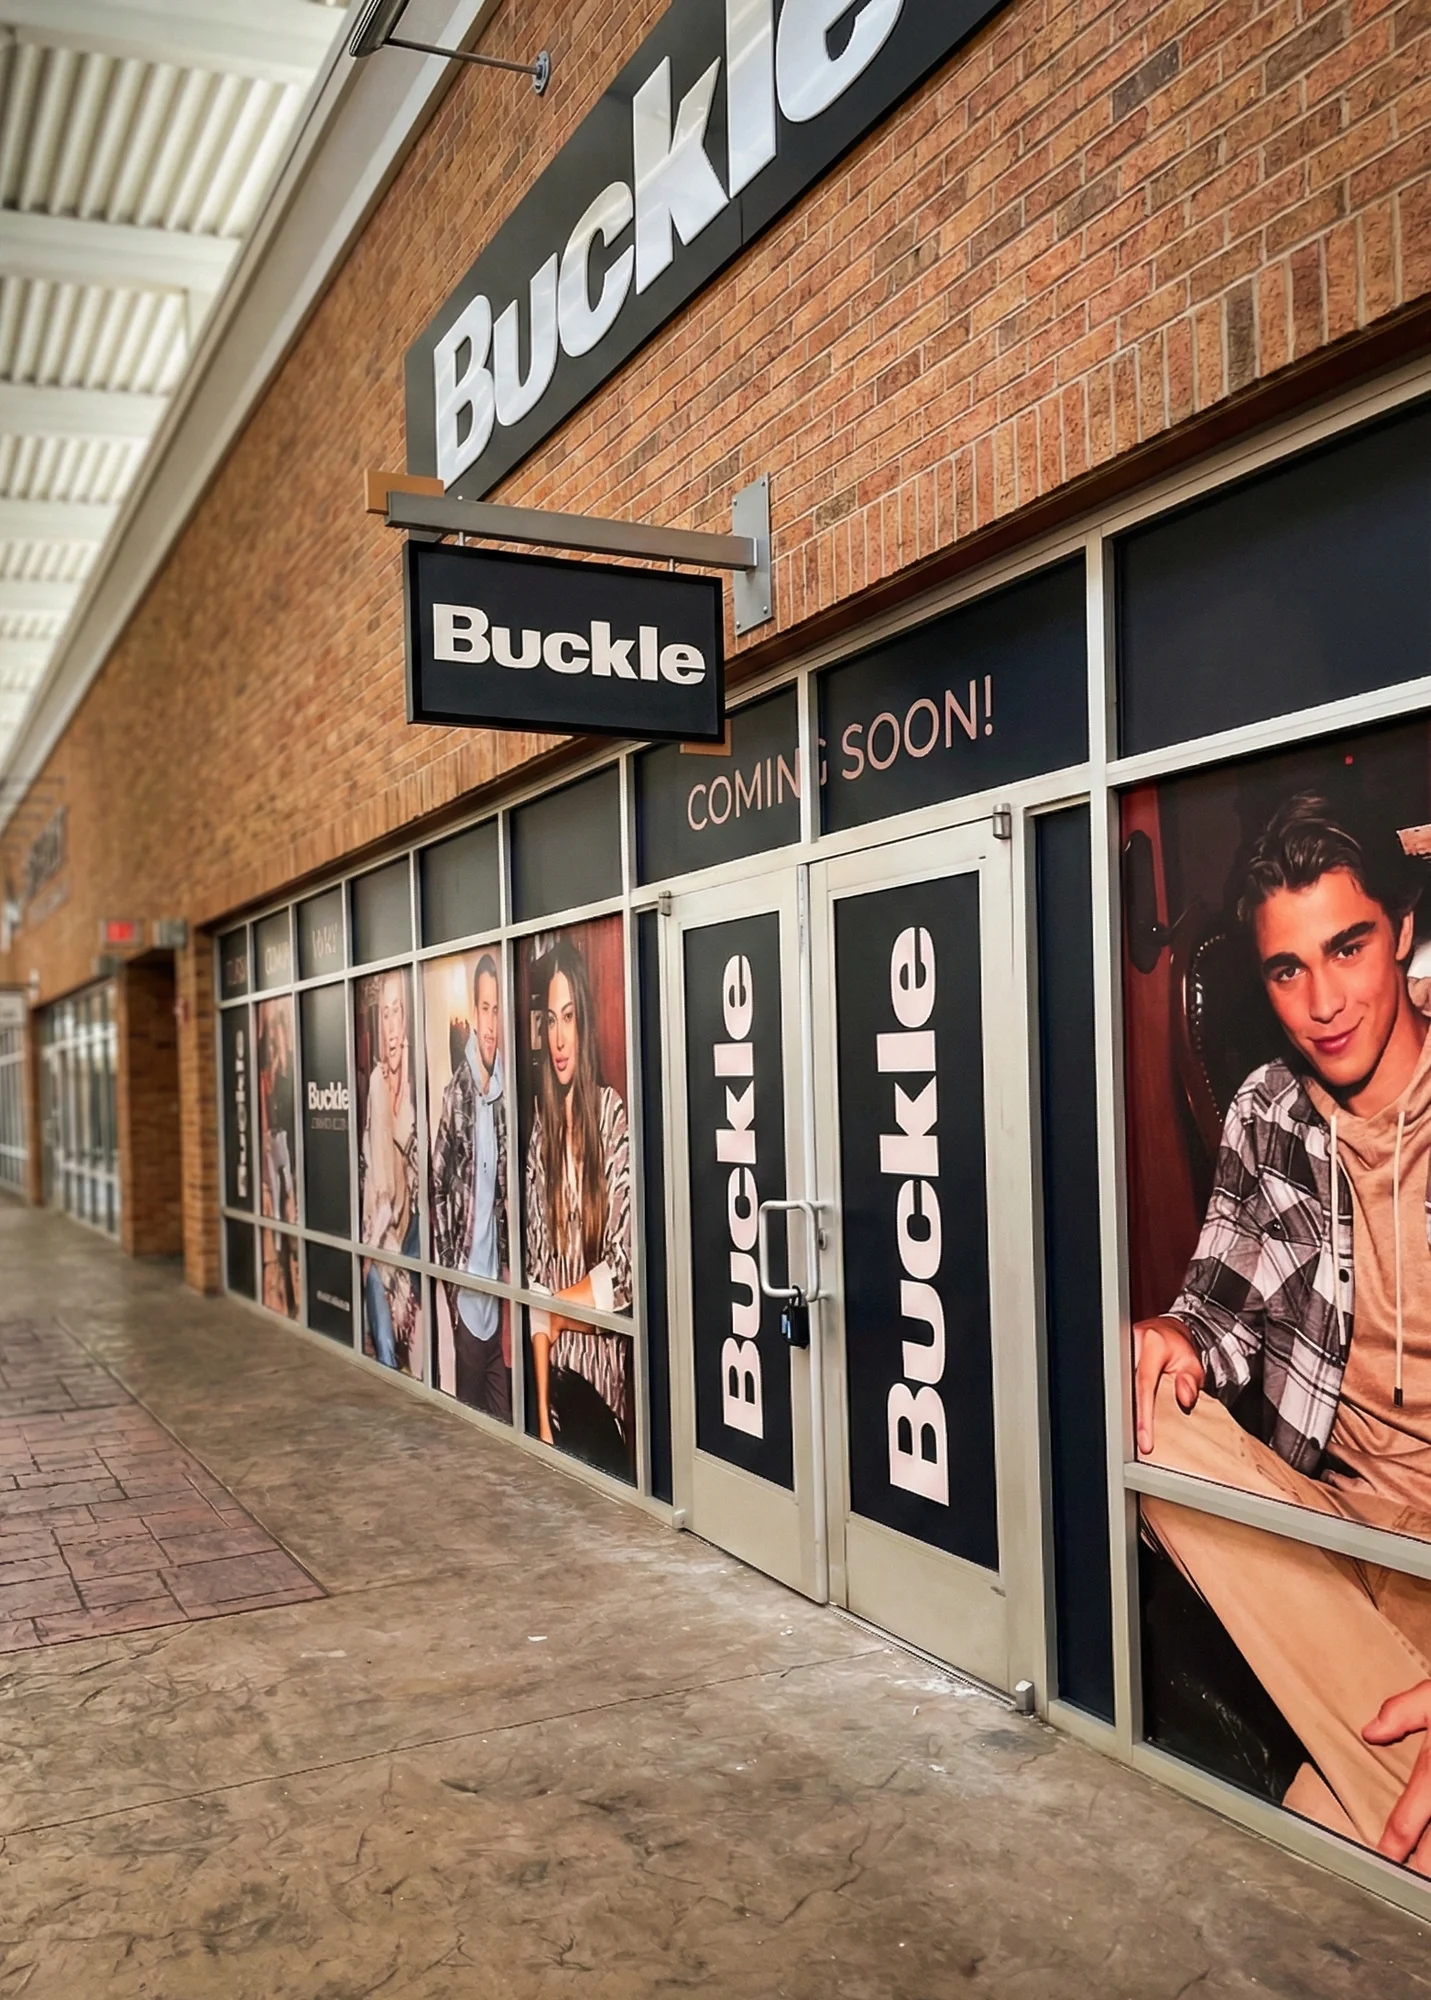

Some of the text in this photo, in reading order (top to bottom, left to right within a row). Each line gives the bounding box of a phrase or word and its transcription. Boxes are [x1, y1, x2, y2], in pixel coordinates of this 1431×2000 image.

[432, 603, 706, 685] Buckle
[841, 674, 995, 781] SOON!
[307, 1081, 349, 1111] Buckle
[713, 954, 764, 1440] Buckle
[876, 926, 950, 1507] Buckle
